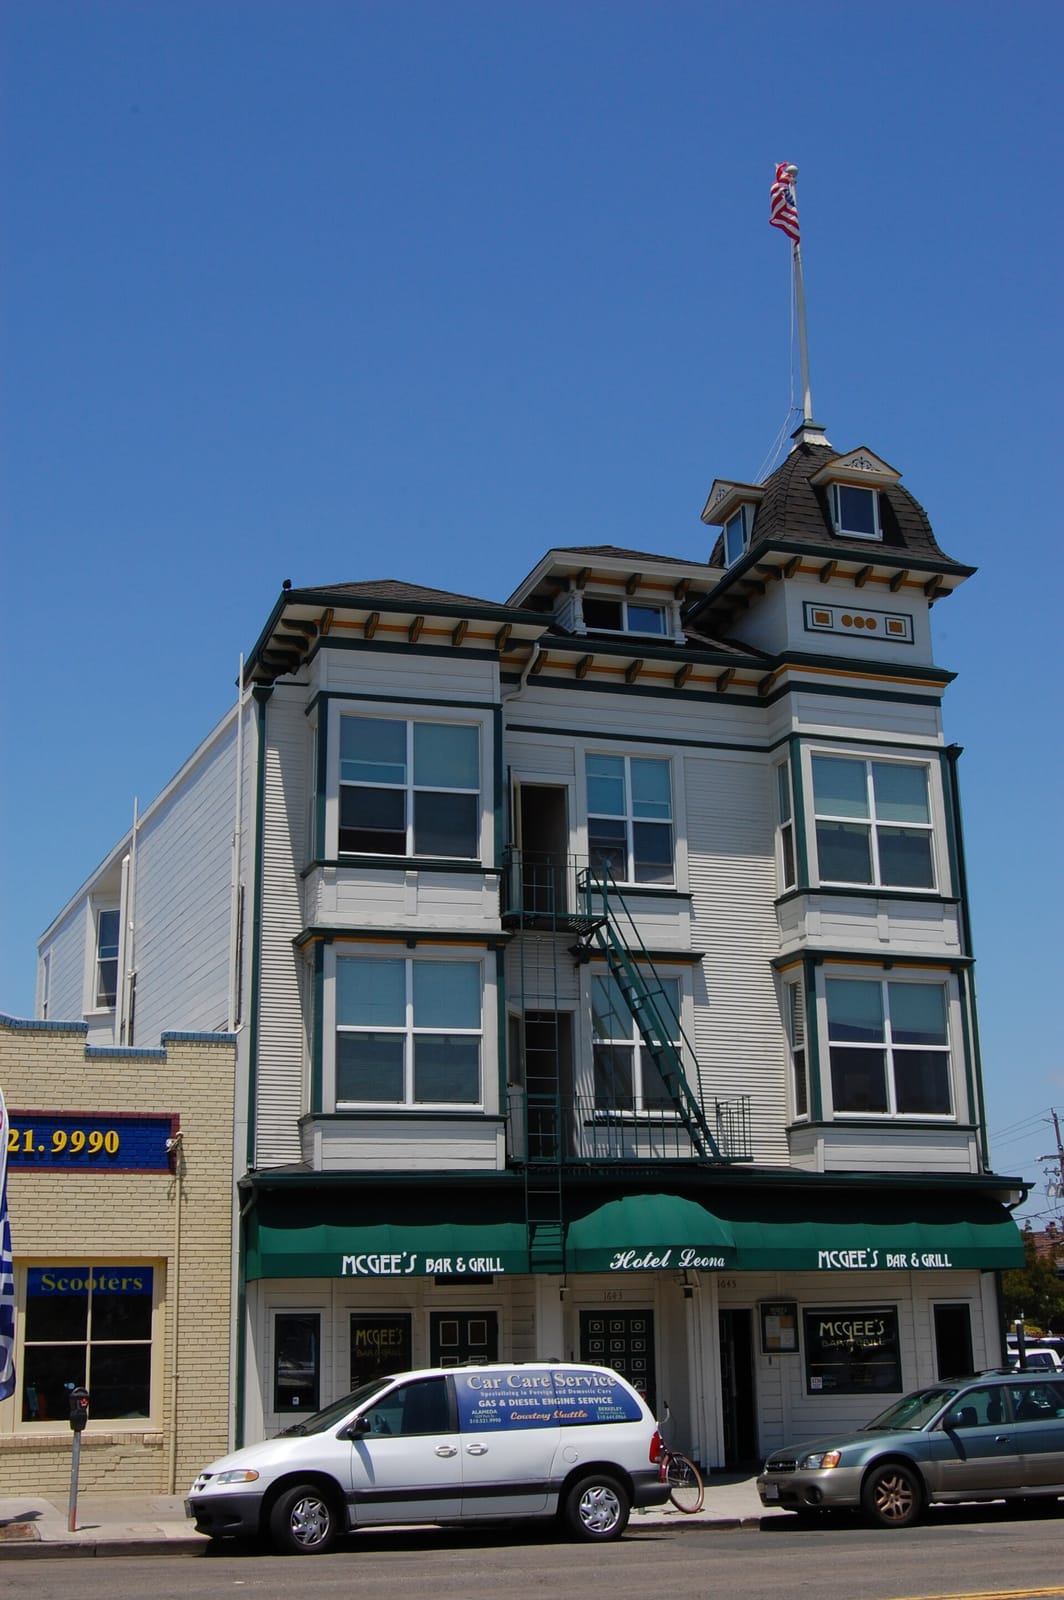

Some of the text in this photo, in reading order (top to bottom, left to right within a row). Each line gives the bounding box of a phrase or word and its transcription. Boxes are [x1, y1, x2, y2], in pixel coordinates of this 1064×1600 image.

[341, 1251, 504, 1275] MCGEE'S BAR & GRILL
[609, 1248, 725, 1269] Hotel Leona
[818, 1248, 952, 1268] MCGEE'S BAR & GRILL
[41, 1273, 143, 1291] Scooters
[819, 1320, 885, 1338] MCGEE'S
[466, 1372, 617, 1390] Car Care Service
[478, 1399, 496, 1407] GAS
[509, 1398, 540, 1406] DIESEL
[542, 1397, 576, 1405] ENGINE
[553, 1410, 588, 1419] Shuttle
